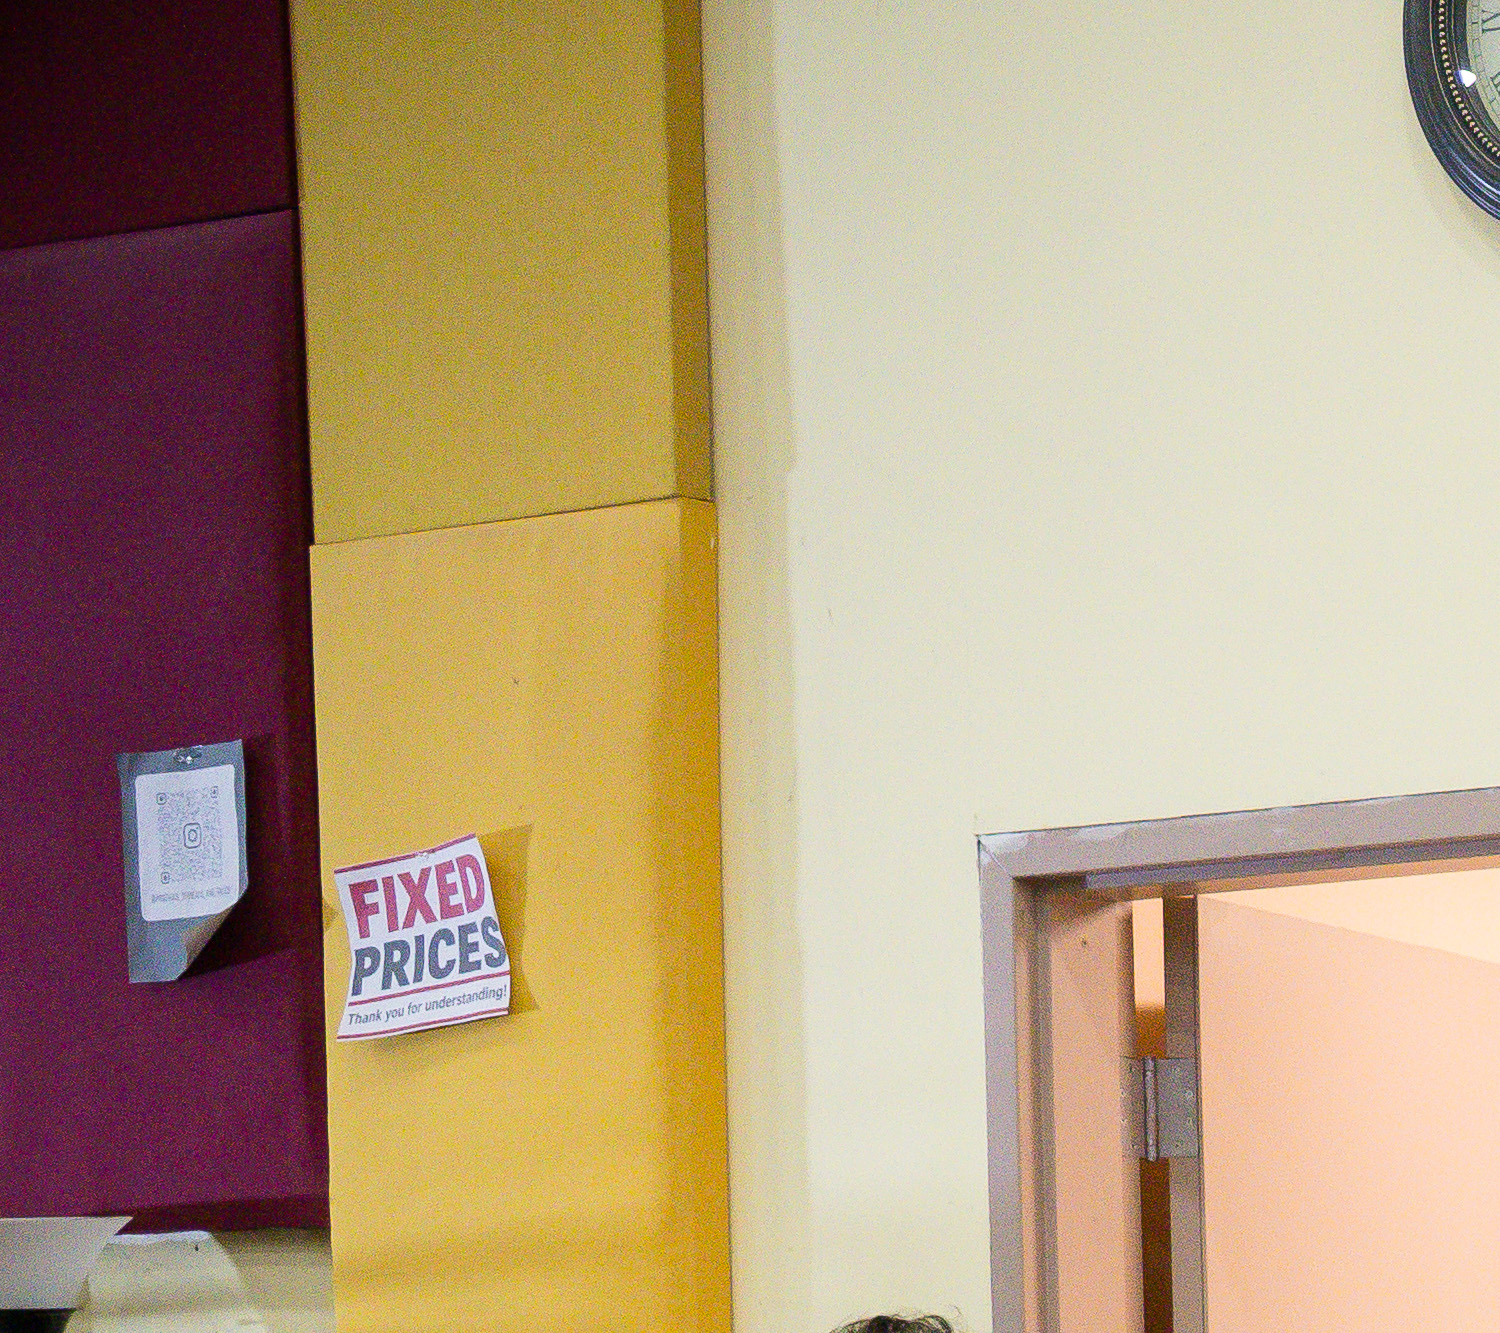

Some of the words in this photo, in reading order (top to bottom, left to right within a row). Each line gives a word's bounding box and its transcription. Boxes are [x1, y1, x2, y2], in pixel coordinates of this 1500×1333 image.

[348, 853, 485, 939] FIXED
[351, 916, 507, 996] PRICES
[348, 1009, 383, 1025] Thank
[385, 1008, 405, 1023] you
[407, 1001, 423, 1015] for
[424, 984, 508, 1011] understanding!
